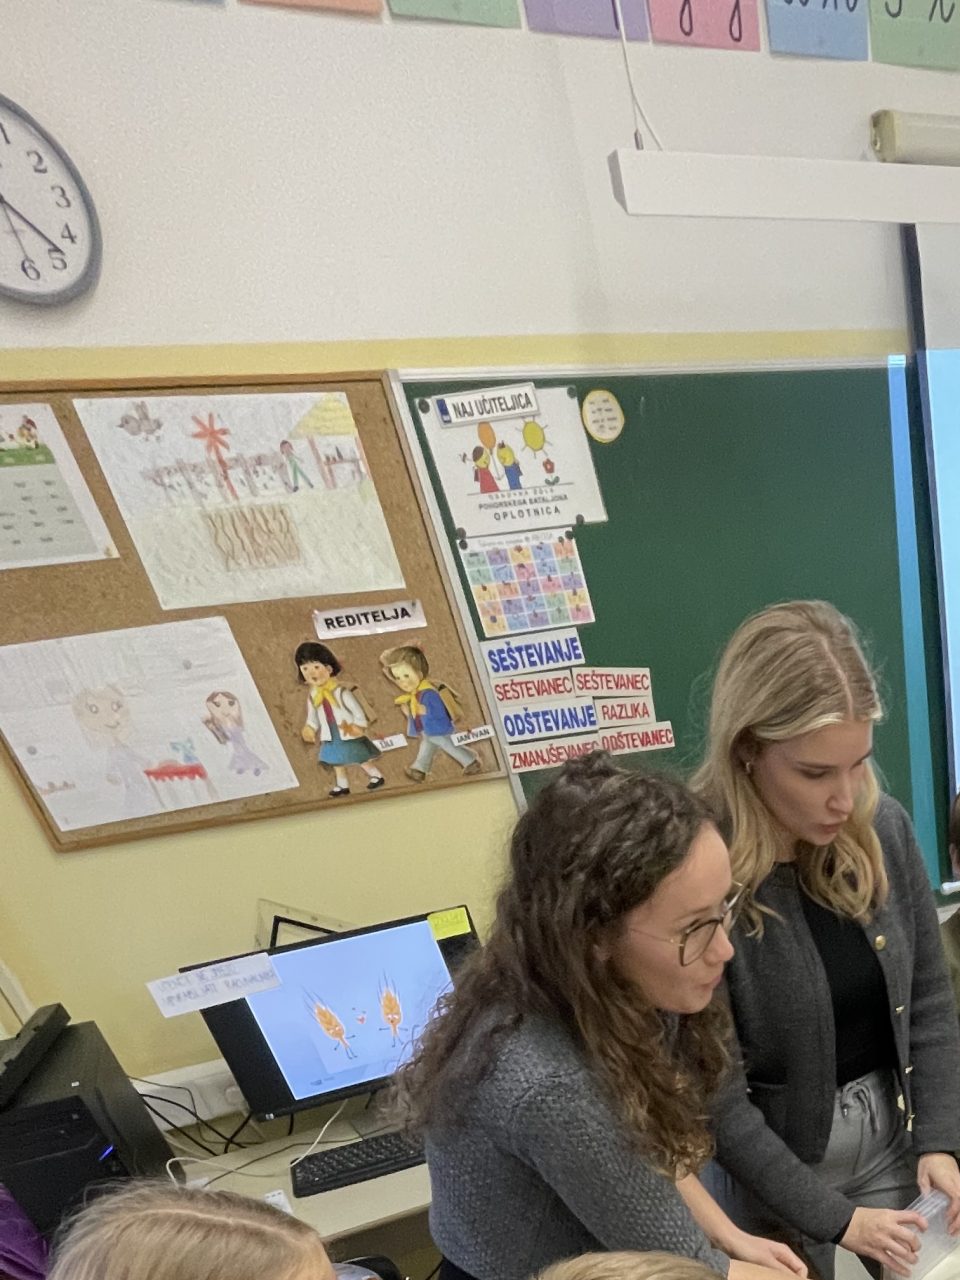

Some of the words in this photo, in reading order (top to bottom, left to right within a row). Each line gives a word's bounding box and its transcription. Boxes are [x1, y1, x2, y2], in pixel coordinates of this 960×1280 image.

[26, 150, 48, 174] 2
[50, 185, 71, 209] 3
[60, 222, 77, 245] 4
[20, 258, 41, 281] 6
[47, 248, 68, 271] 5
[452, 399, 474, 419] NAJ
[477, 392, 533, 415] UČITELJICA
[493, 505, 561, 521] OPLOTNICA
[323, 606, 412, 631] REDITELJA
[487, 636, 583, 673] SEŠTEVANJE
[494, 676, 573, 702] SEŠTEVANEC
[576, 669, 650, 691] SEŠTEVANEC
[503, 704, 597, 738] ODŠTEVANJE
[601, 701, 650, 721] RAZLIKA
[601, 728, 674, 752] ODŠTEVANEC
